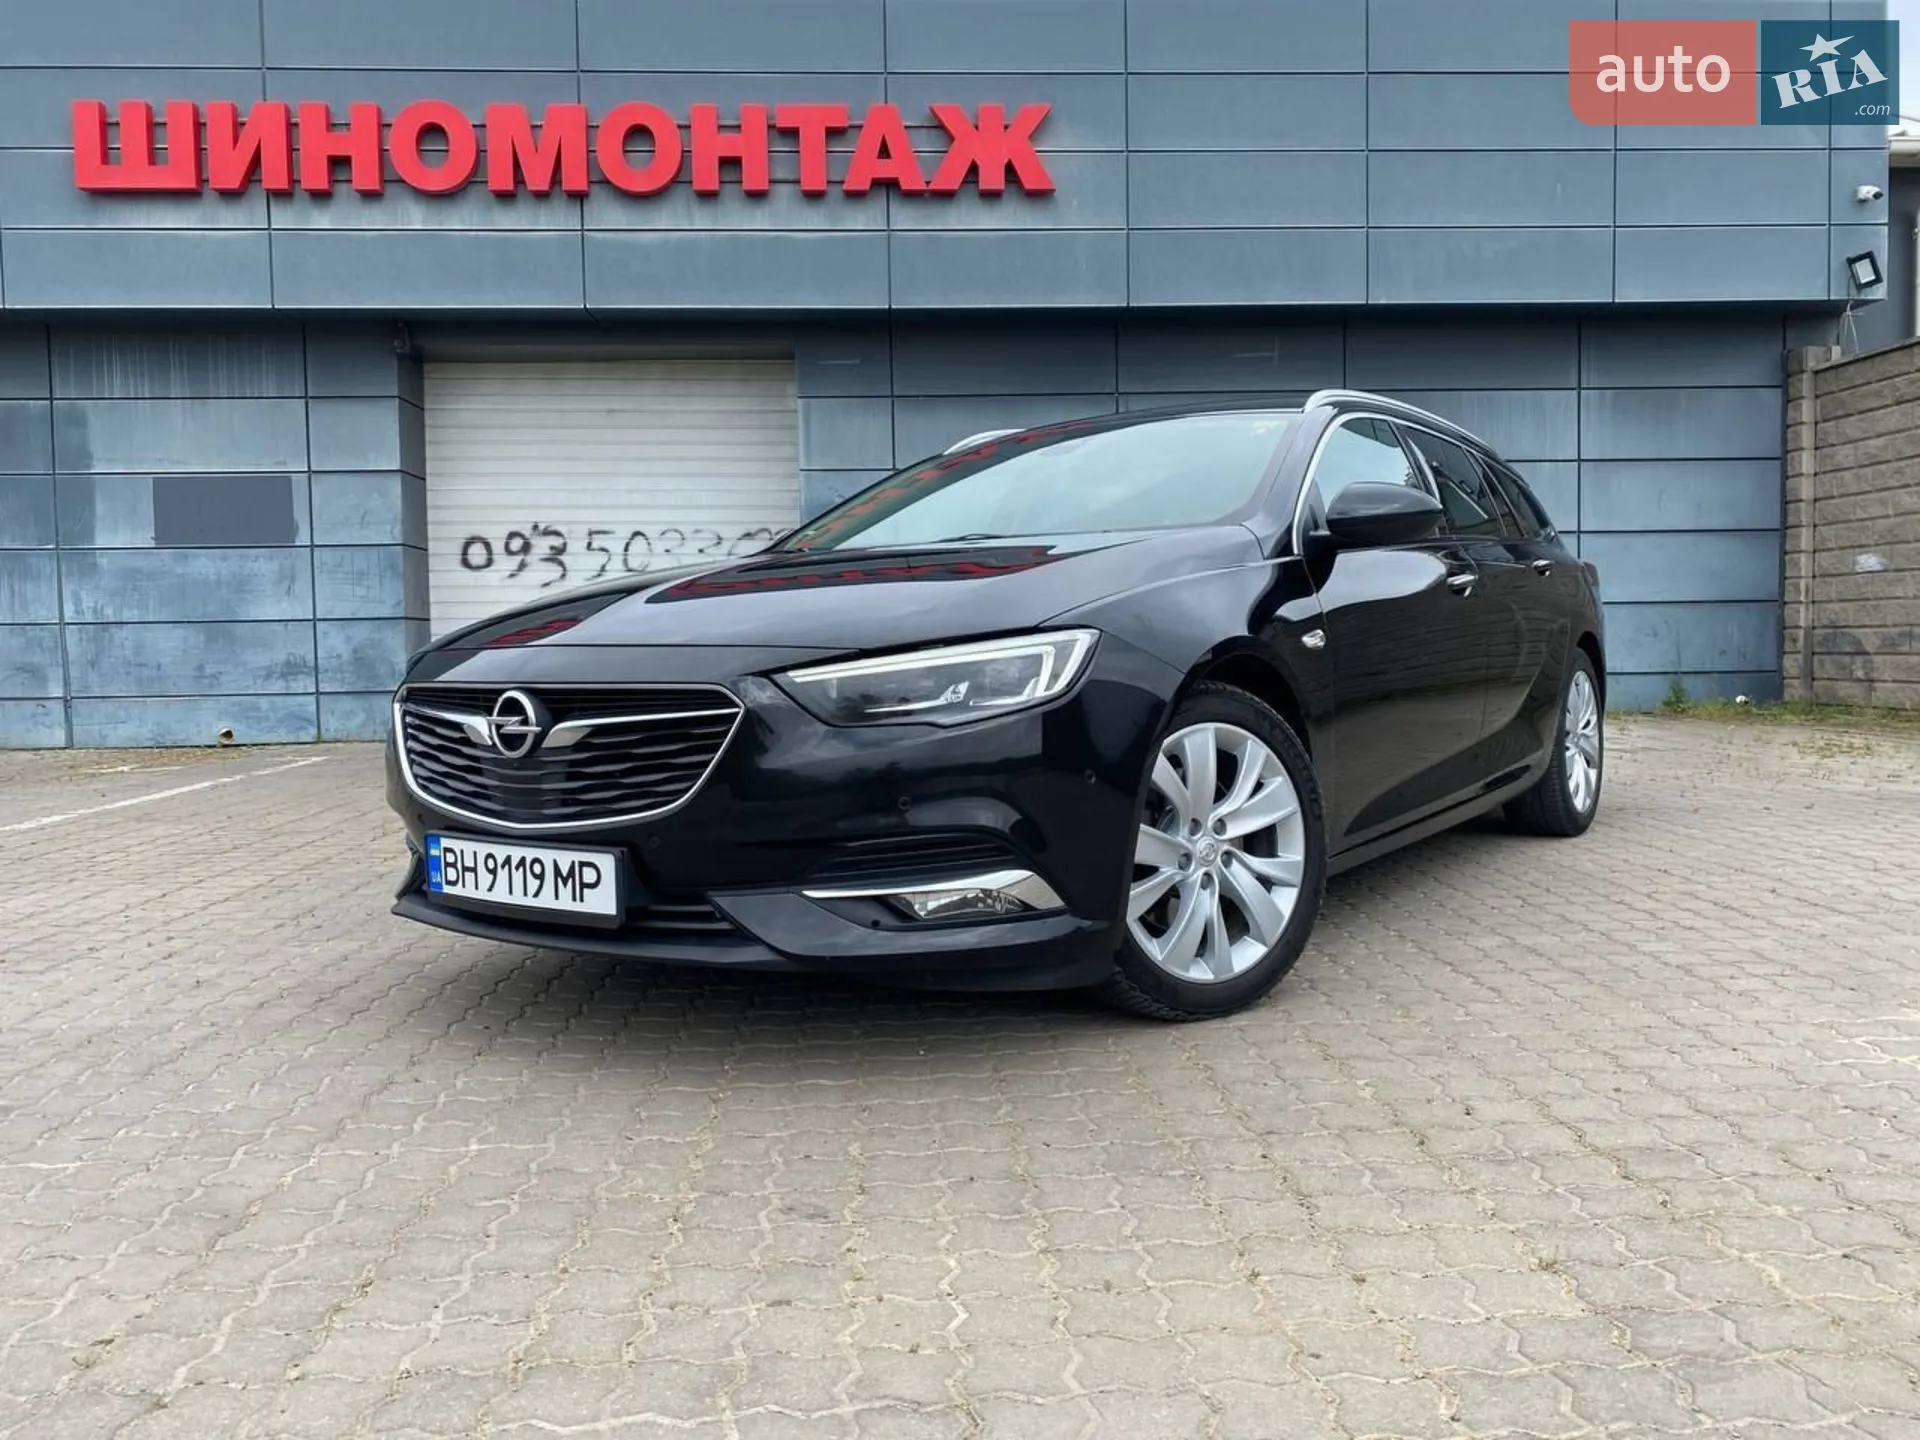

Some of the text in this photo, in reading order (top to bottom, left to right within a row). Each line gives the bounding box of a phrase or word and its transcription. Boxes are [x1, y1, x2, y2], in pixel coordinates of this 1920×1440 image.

[71, 100, 1055, 196] ШИНОМОНТАЖ
[443, 847, 602, 903] BH 9119 MP
